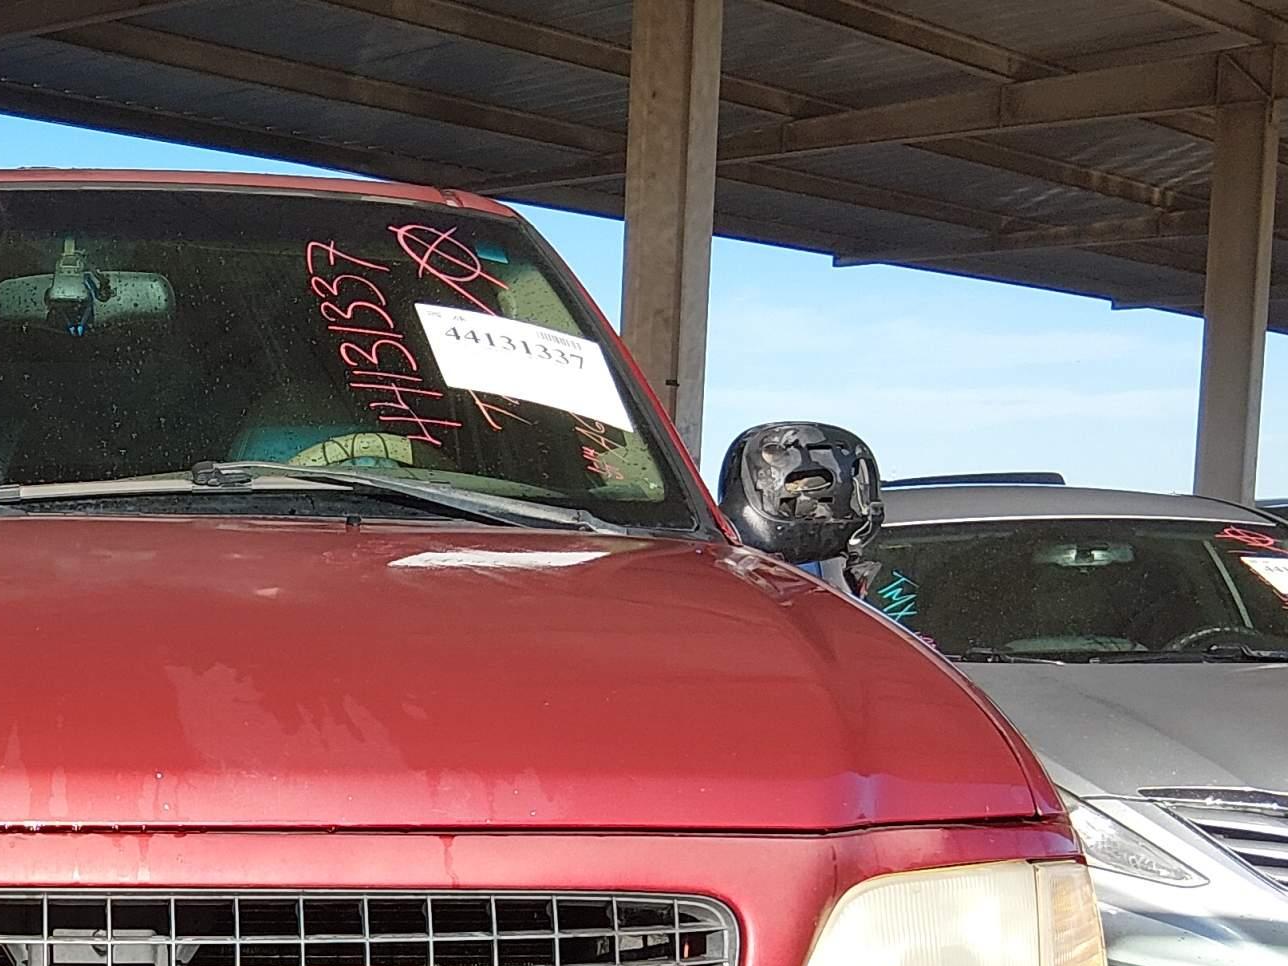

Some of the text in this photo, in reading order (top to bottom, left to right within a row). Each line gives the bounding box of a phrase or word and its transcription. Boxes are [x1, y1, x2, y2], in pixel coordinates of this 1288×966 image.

[306, 240, 462, 446] 44131337
[445, 326, 584, 369] 44131337
[877, 570, 920, 621] TMX
